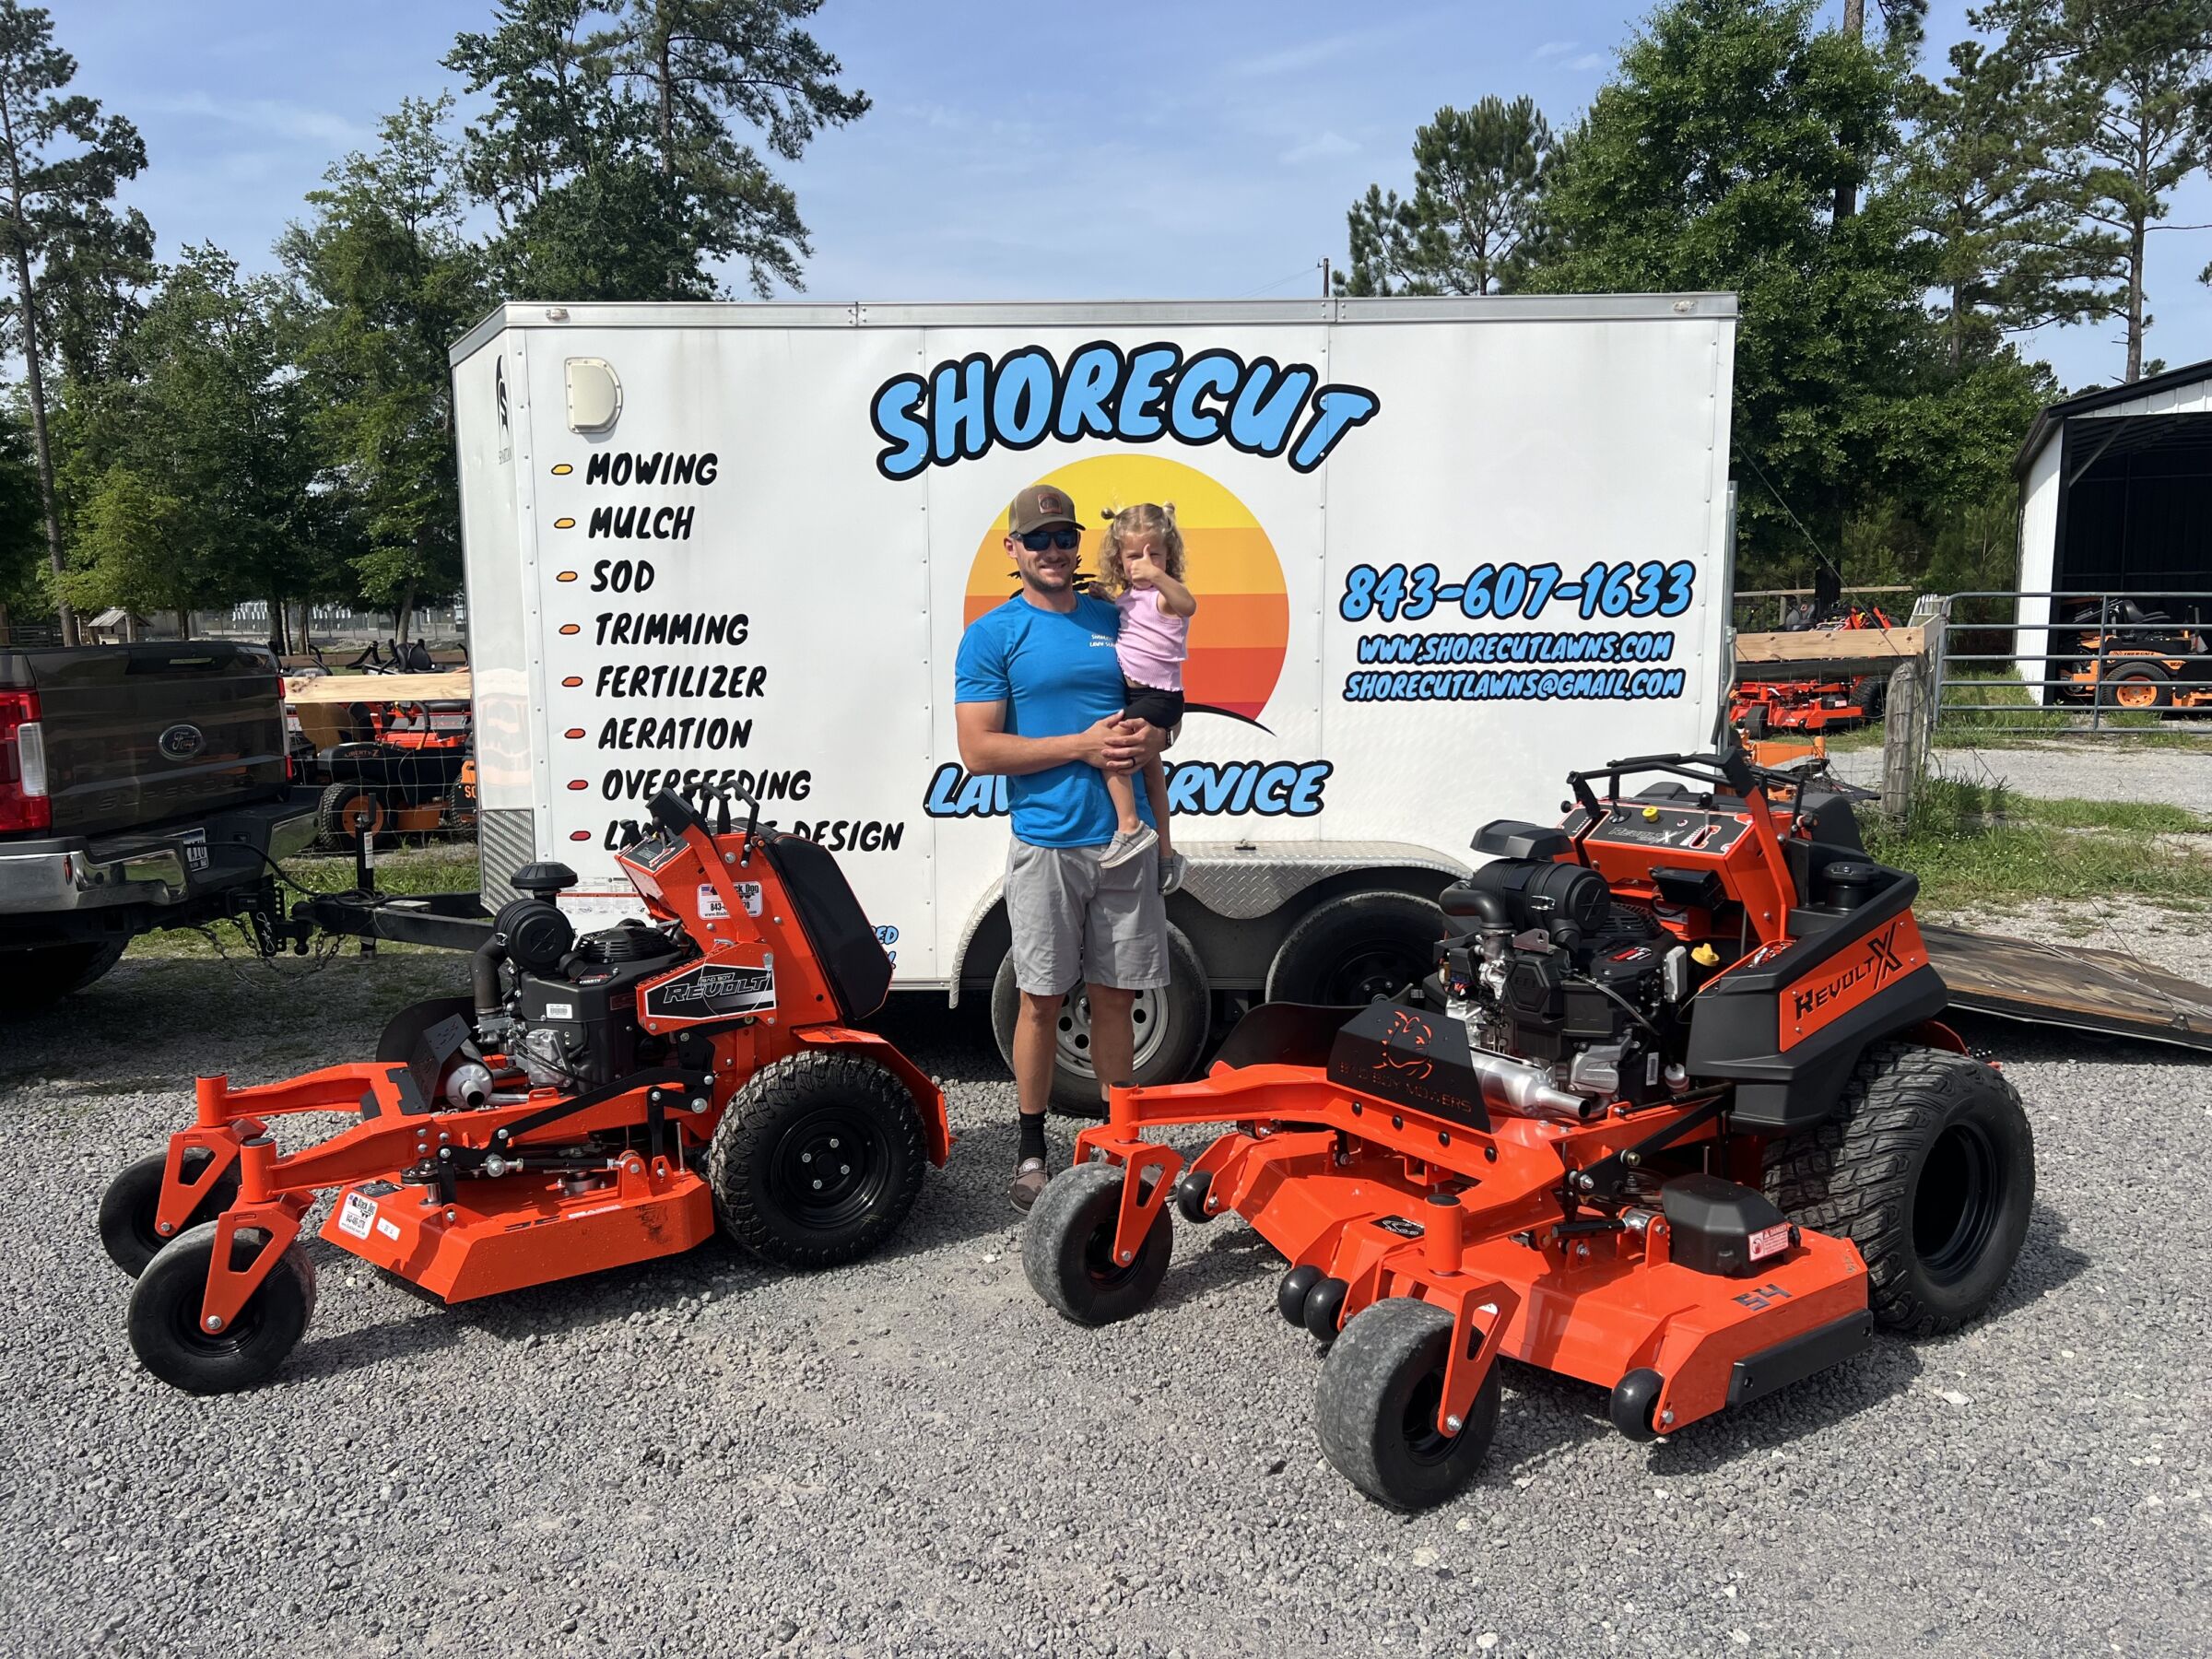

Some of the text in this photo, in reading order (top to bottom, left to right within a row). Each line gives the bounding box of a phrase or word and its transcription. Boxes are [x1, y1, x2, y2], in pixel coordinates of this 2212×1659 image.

[870, 339, 1381, 481] SHORECUT
[585, 452, 718, 487] MOWING
[588, 505, 696, 540] MULCH
[590, 559, 655, 594] SOD
[1339, 559, 1697, 622] 843-607-1633
[595, 612, 749, 646] TRIMMING
[1358, 630, 1676, 665] WWW.SHORECUTLAWNS.COM
[595, 665, 768, 699] FERTILIZER
[1342, 668, 1687, 702] SHORECUTLAWNS@GMAIL.COM
[597, 717, 753, 750] AERATION
[923, 759, 1334, 818] LA RVICE
[794, 820, 905, 852] DESIGN
[664, 976, 769, 1004] REVOLT
